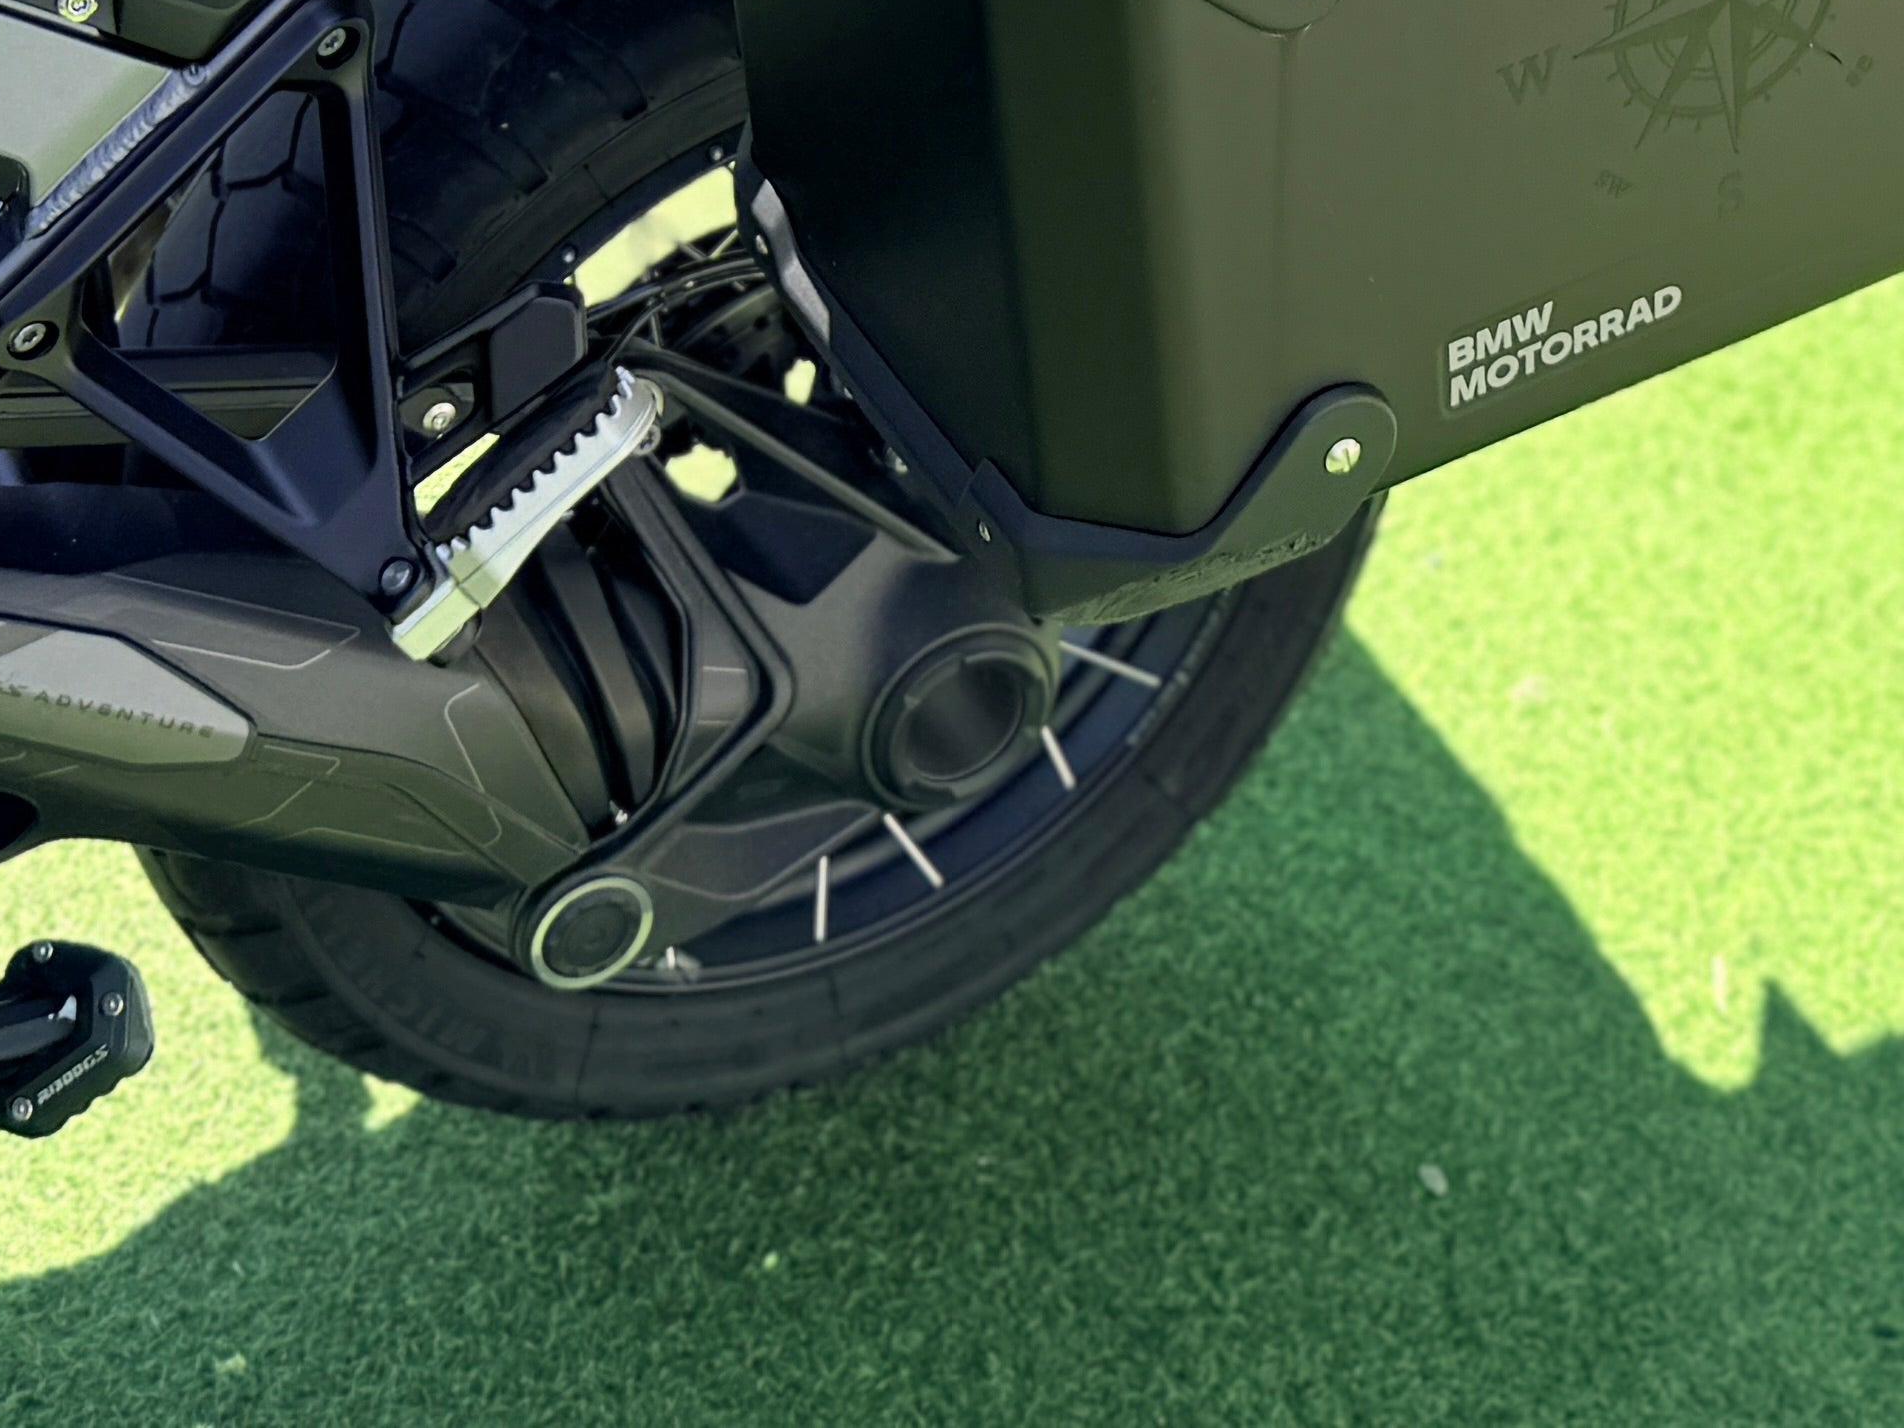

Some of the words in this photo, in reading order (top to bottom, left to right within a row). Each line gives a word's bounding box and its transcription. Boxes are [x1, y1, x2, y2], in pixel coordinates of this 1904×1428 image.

[1496, 44, 1561, 106] W
[1717, 170, 1746, 220] S
[1448, 301, 1553, 372] BMW
[1450, 285, 1682, 407] MOTORRAD
[33, 690, 215, 739] ADVENTURE
